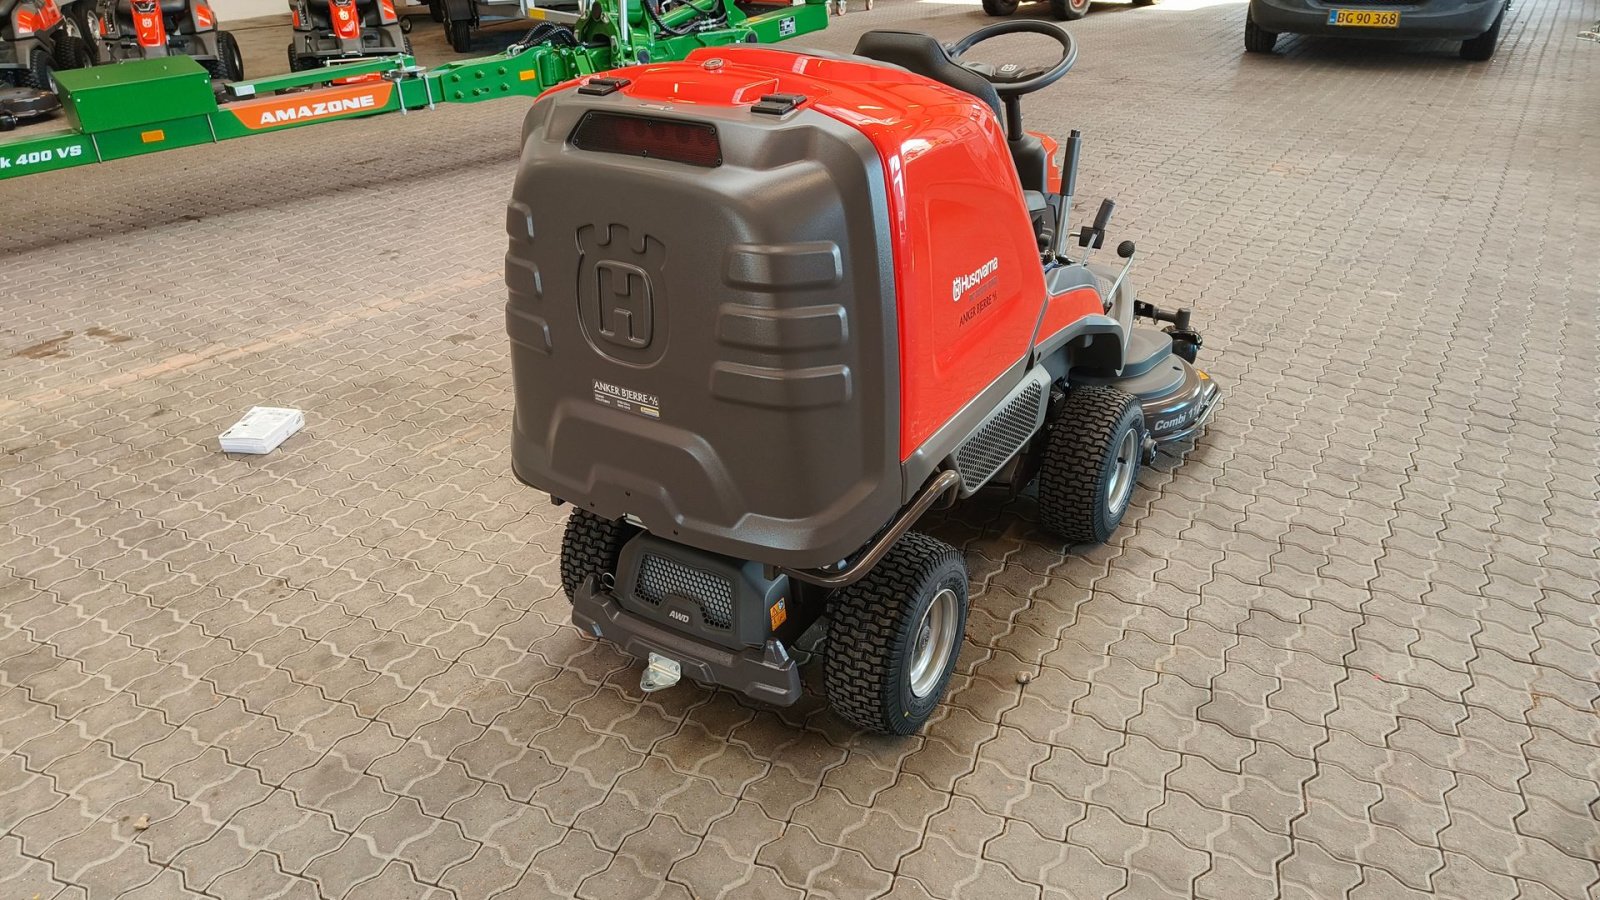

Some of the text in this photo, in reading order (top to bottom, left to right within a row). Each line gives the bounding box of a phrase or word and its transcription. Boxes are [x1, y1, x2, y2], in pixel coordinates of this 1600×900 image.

[1337, 12, 1397, 25] BG 90 368
[260, 94, 375, 125] AMAZONE
[15, 149, 53, 166] 400
[56, 144, 82, 159] VS
[961, 256, 998, 294] Husqvarna
[594, 380, 620, 396] ANKER
[621, 388, 648, 404] BJERRE
[1154, 411, 1187, 431] Combi
[669, 610, 690, 623] AWD
